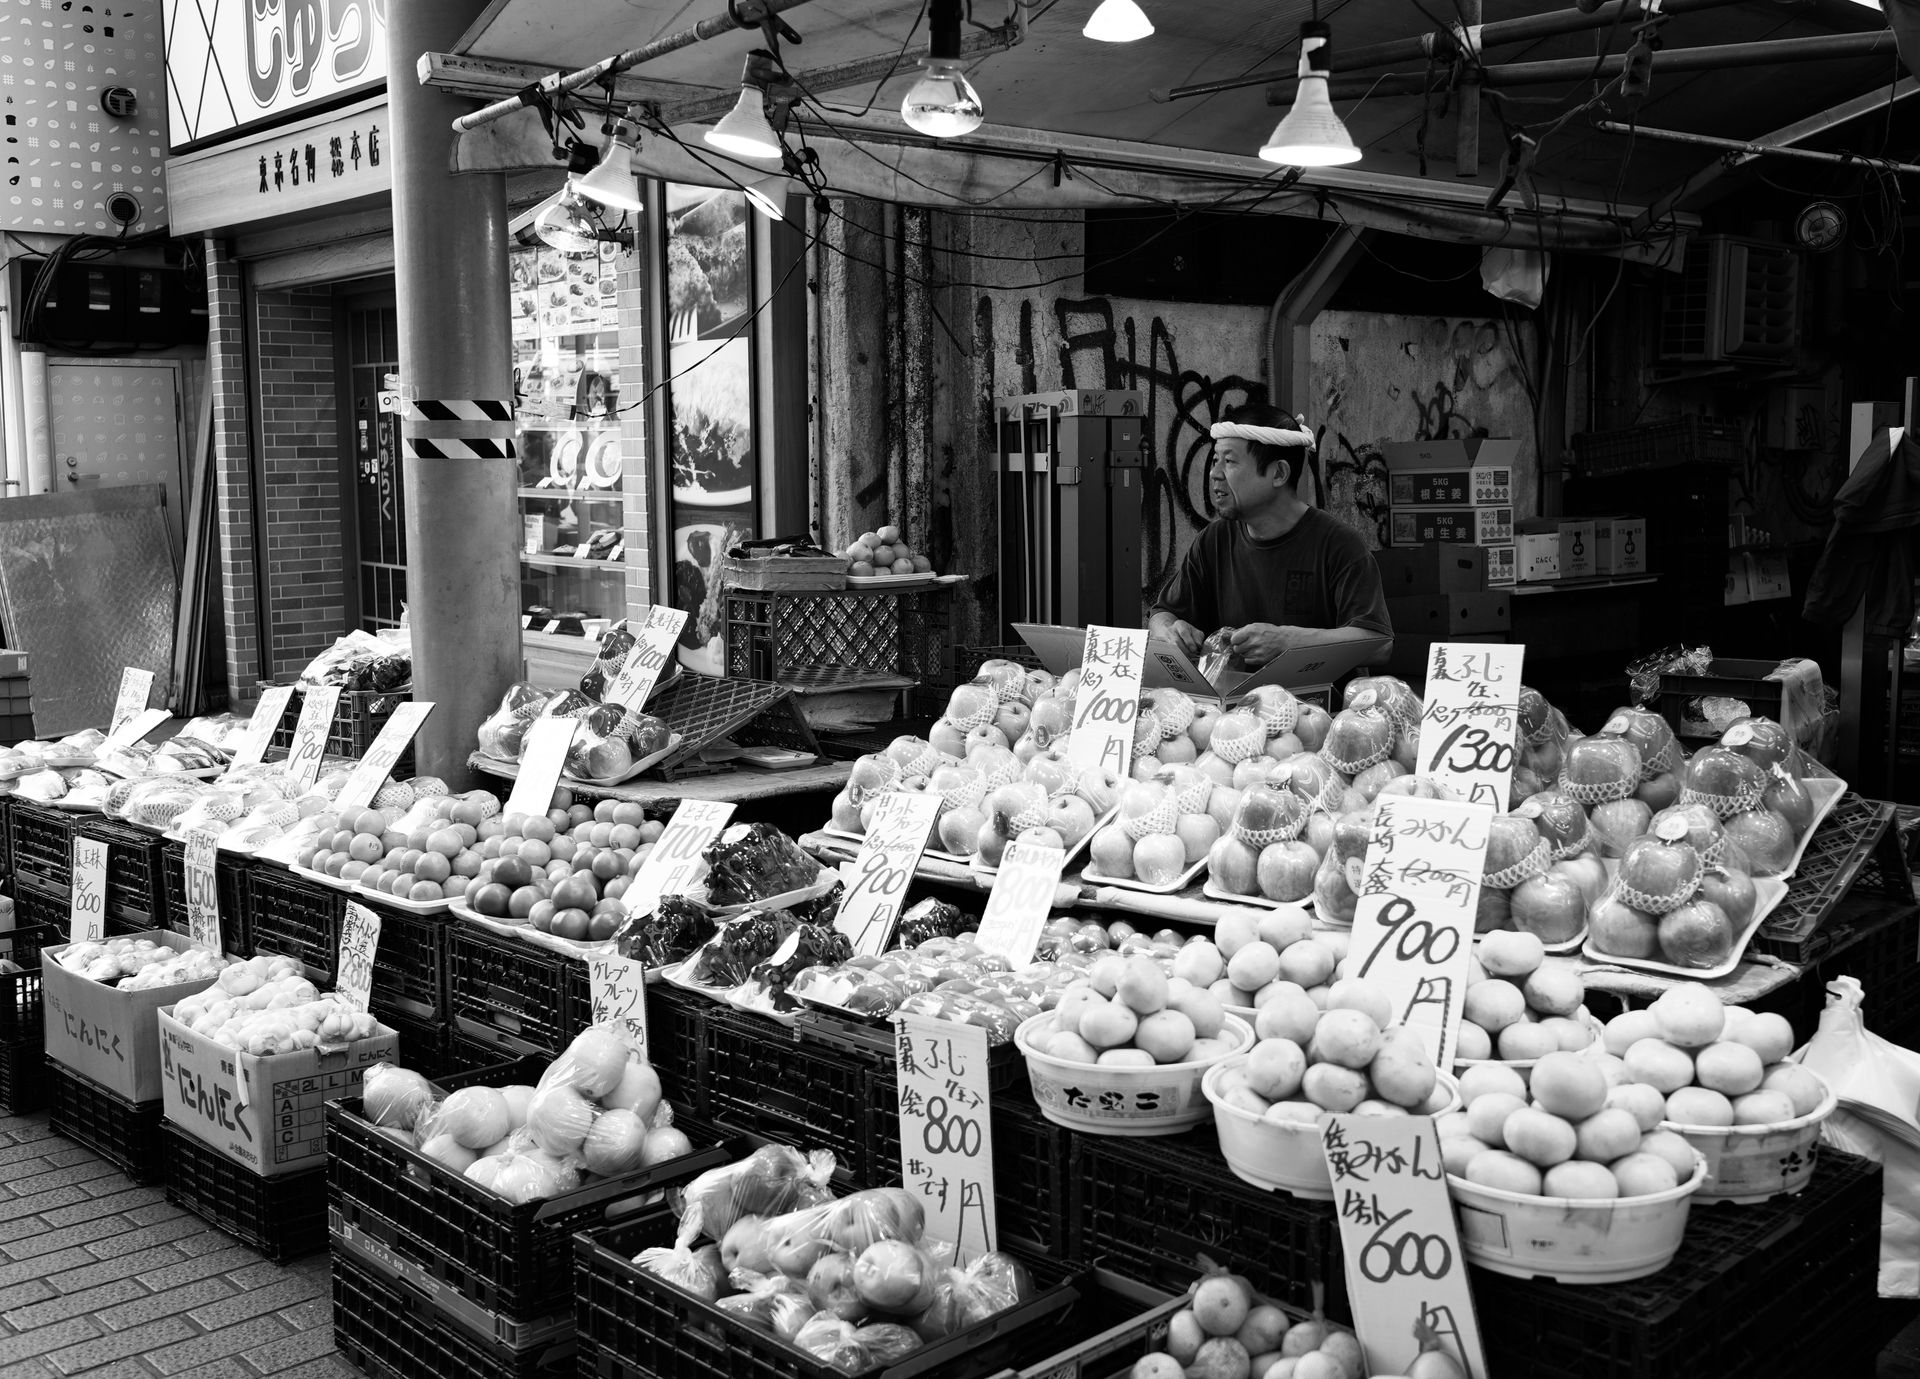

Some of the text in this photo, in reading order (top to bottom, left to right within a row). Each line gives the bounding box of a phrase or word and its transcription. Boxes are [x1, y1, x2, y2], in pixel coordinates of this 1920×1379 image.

[1420, 487, 1462, 501] 根生姜
[1432, 477, 1449, 487] 5KG
[1423, 527, 1467, 540] 根生姜
[1436, 516, 1454, 526] 5KG
[1100, 635, 1143, 661] 王林
[1453, 652, 1504, 682] ふじ
[290, 730, 323, 771] 900
[655, 823, 713, 863] 700
[1368, 802, 1396, 854] 長崎
[1399, 817, 1487, 850] みかん
[76, 881, 101, 914] 600
[186, 865, 217, 911] 1500
[841, 853, 906, 914] 900
[992, 866, 1053, 916] 800
[1445, 881, 1470, 908] 円
[206, 914, 218, 946] 円
[1357, 896, 1460, 979] 900
[63, 1008, 125, 1063] にんにく
[1399, 976, 1452, 1070] 円
[358, 1047, 392, 1063] にんにく
[923, 1038, 967, 1077] ふじ
[177, 1062, 252, 1143] にんにく
[302, 1079, 319, 1093] 2L
[329, 1075, 339, 1088] L
[281, 1099, 293, 1113] A
[281, 1114, 293, 1128] B
[282, 1130, 294, 1144] C
[923, 1095, 982, 1157] 800
[1322, 1117, 1370, 1182] 佐賀
[1349, 1134, 1443, 1181] みかん
[952, 1178, 991, 1268] 円
[1359, 1208, 1452, 1284] 600
[1413, 1300, 1473, 1379] 円
